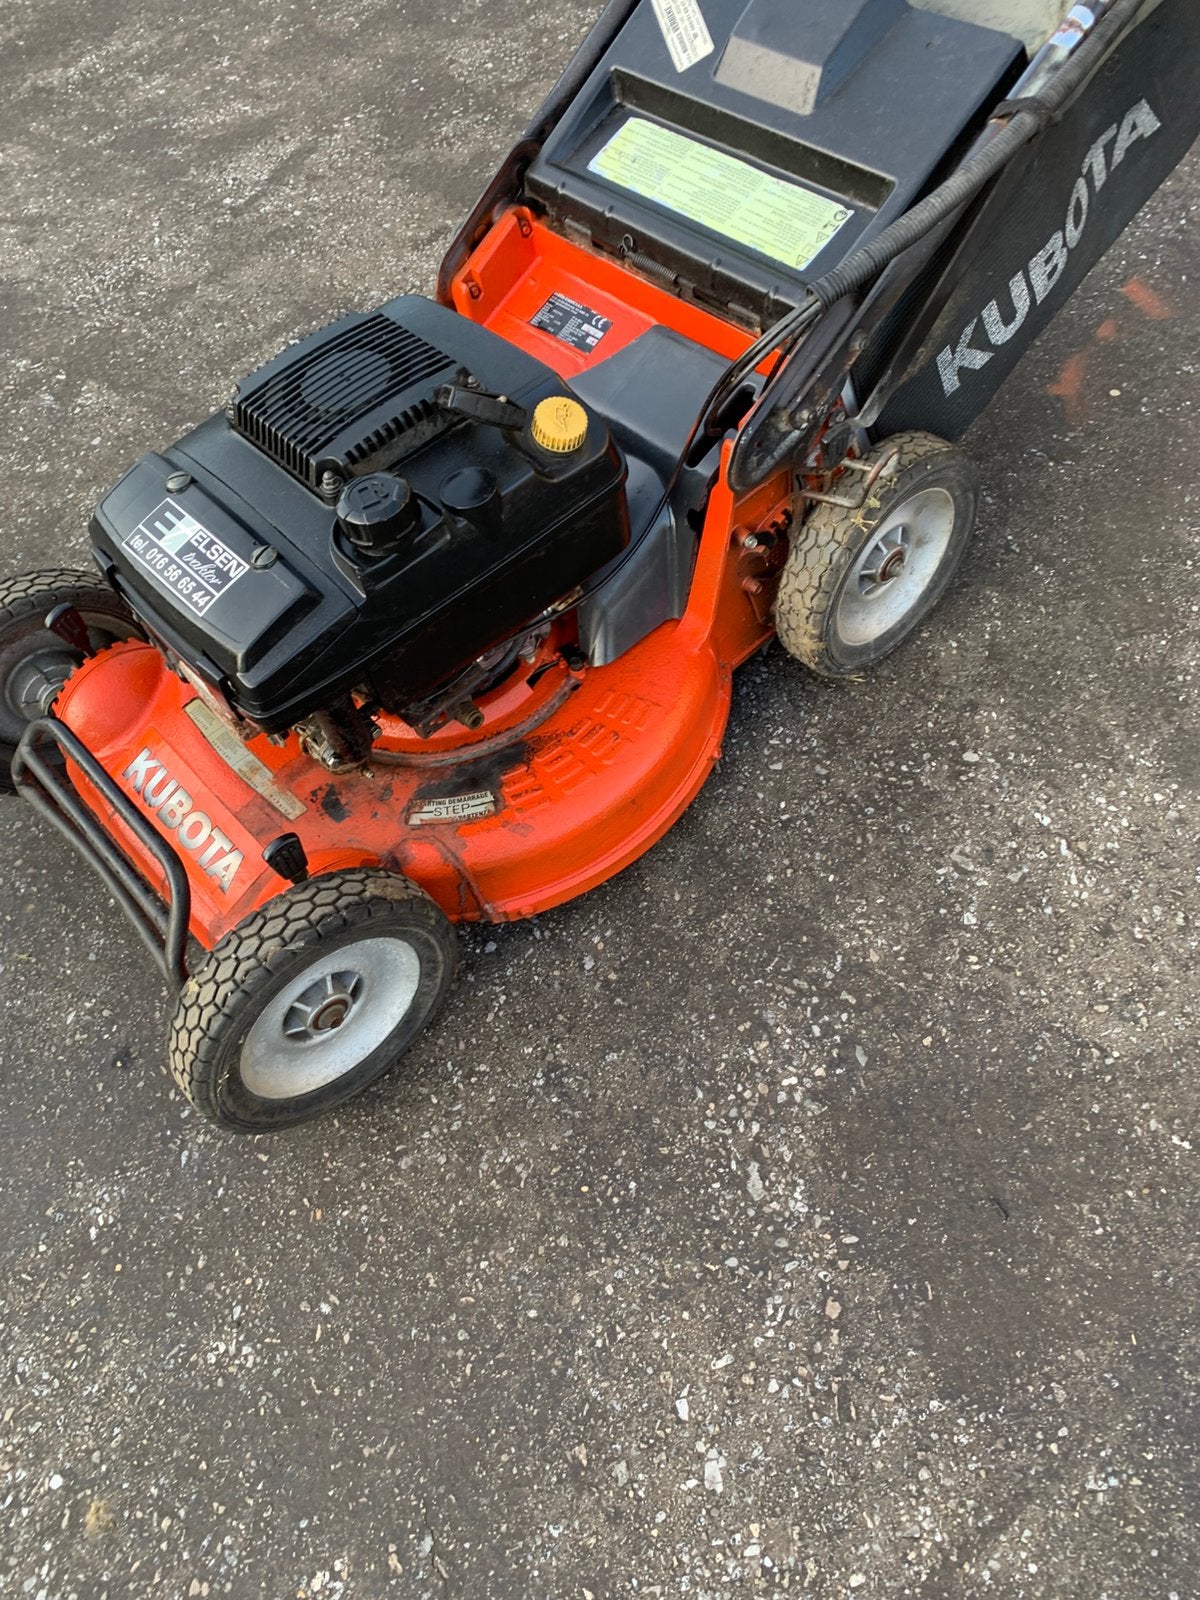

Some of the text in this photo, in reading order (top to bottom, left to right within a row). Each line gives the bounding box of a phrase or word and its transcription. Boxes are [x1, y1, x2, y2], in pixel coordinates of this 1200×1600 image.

[936, 98, 1162, 398] KUBOTA
[129, 534, 211, 607] tel. 016 56 65 44
[182, 552, 222, 585] traktor
[189, 528, 244, 578] ELSEN
[122, 746, 245, 894] KUBOTA
[433, 803, 470, 817] STEP
